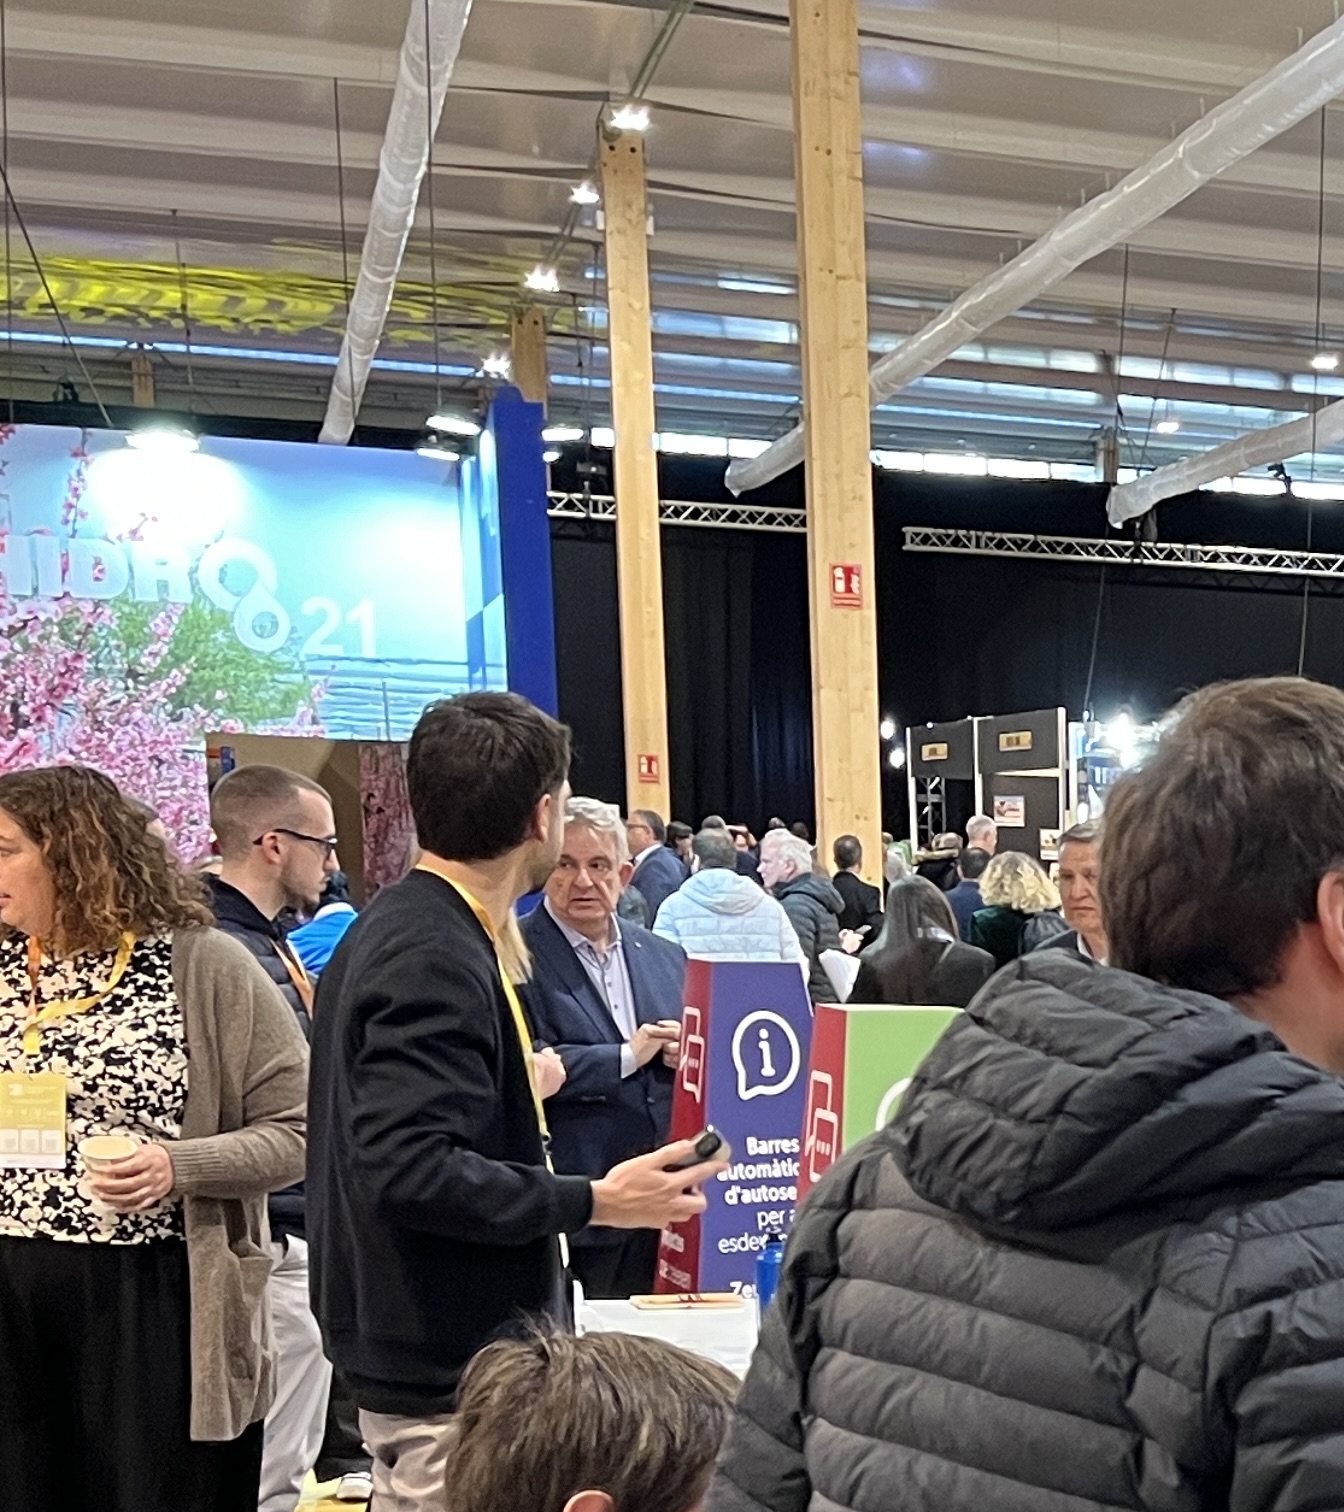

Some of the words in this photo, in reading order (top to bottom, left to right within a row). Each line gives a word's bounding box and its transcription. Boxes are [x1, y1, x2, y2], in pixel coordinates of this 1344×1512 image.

[301, 597, 378, 659] 21
[746, 1136, 800, 1155] Barres
[757, 1210, 785, 1230] per
